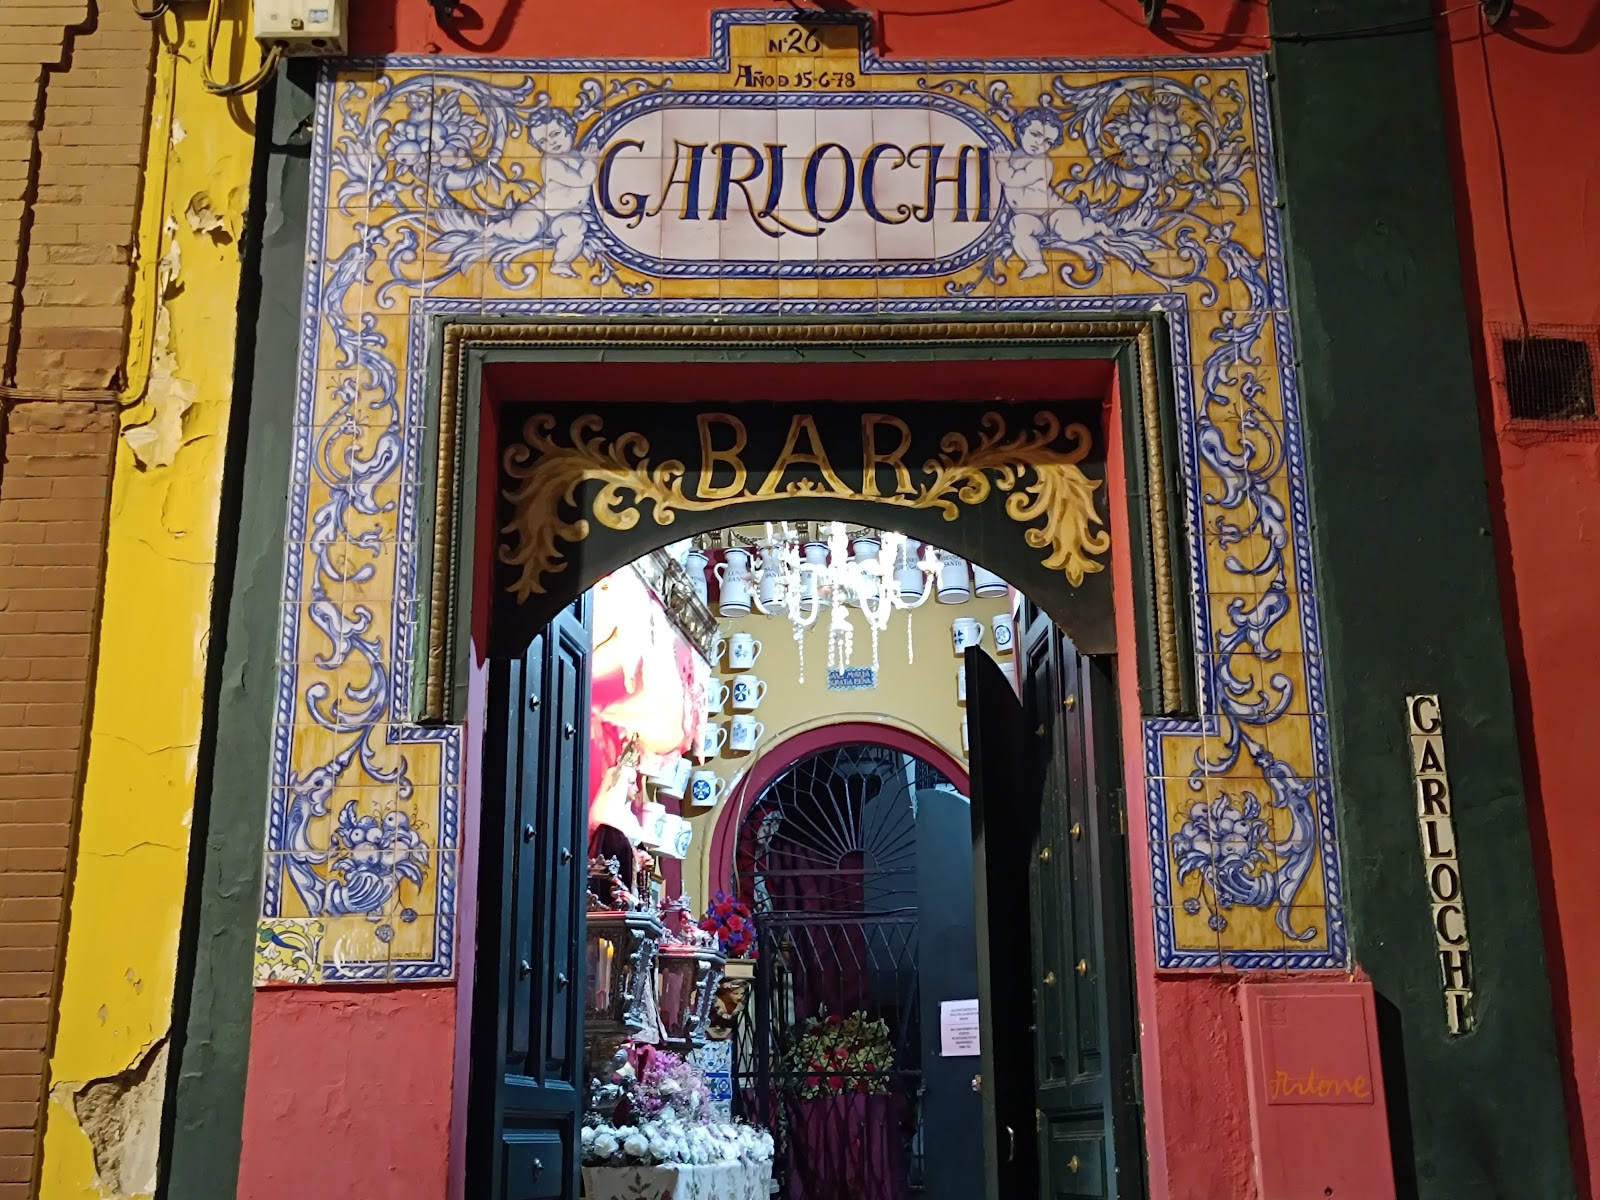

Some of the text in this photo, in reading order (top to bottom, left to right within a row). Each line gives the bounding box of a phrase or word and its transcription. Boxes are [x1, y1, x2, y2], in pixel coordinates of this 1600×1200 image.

[599, 138, 991, 237] GARLOCHI
[696, 412, 918, 498] BAR
[1413, 696, 1469, 1034] GARLOCHI
